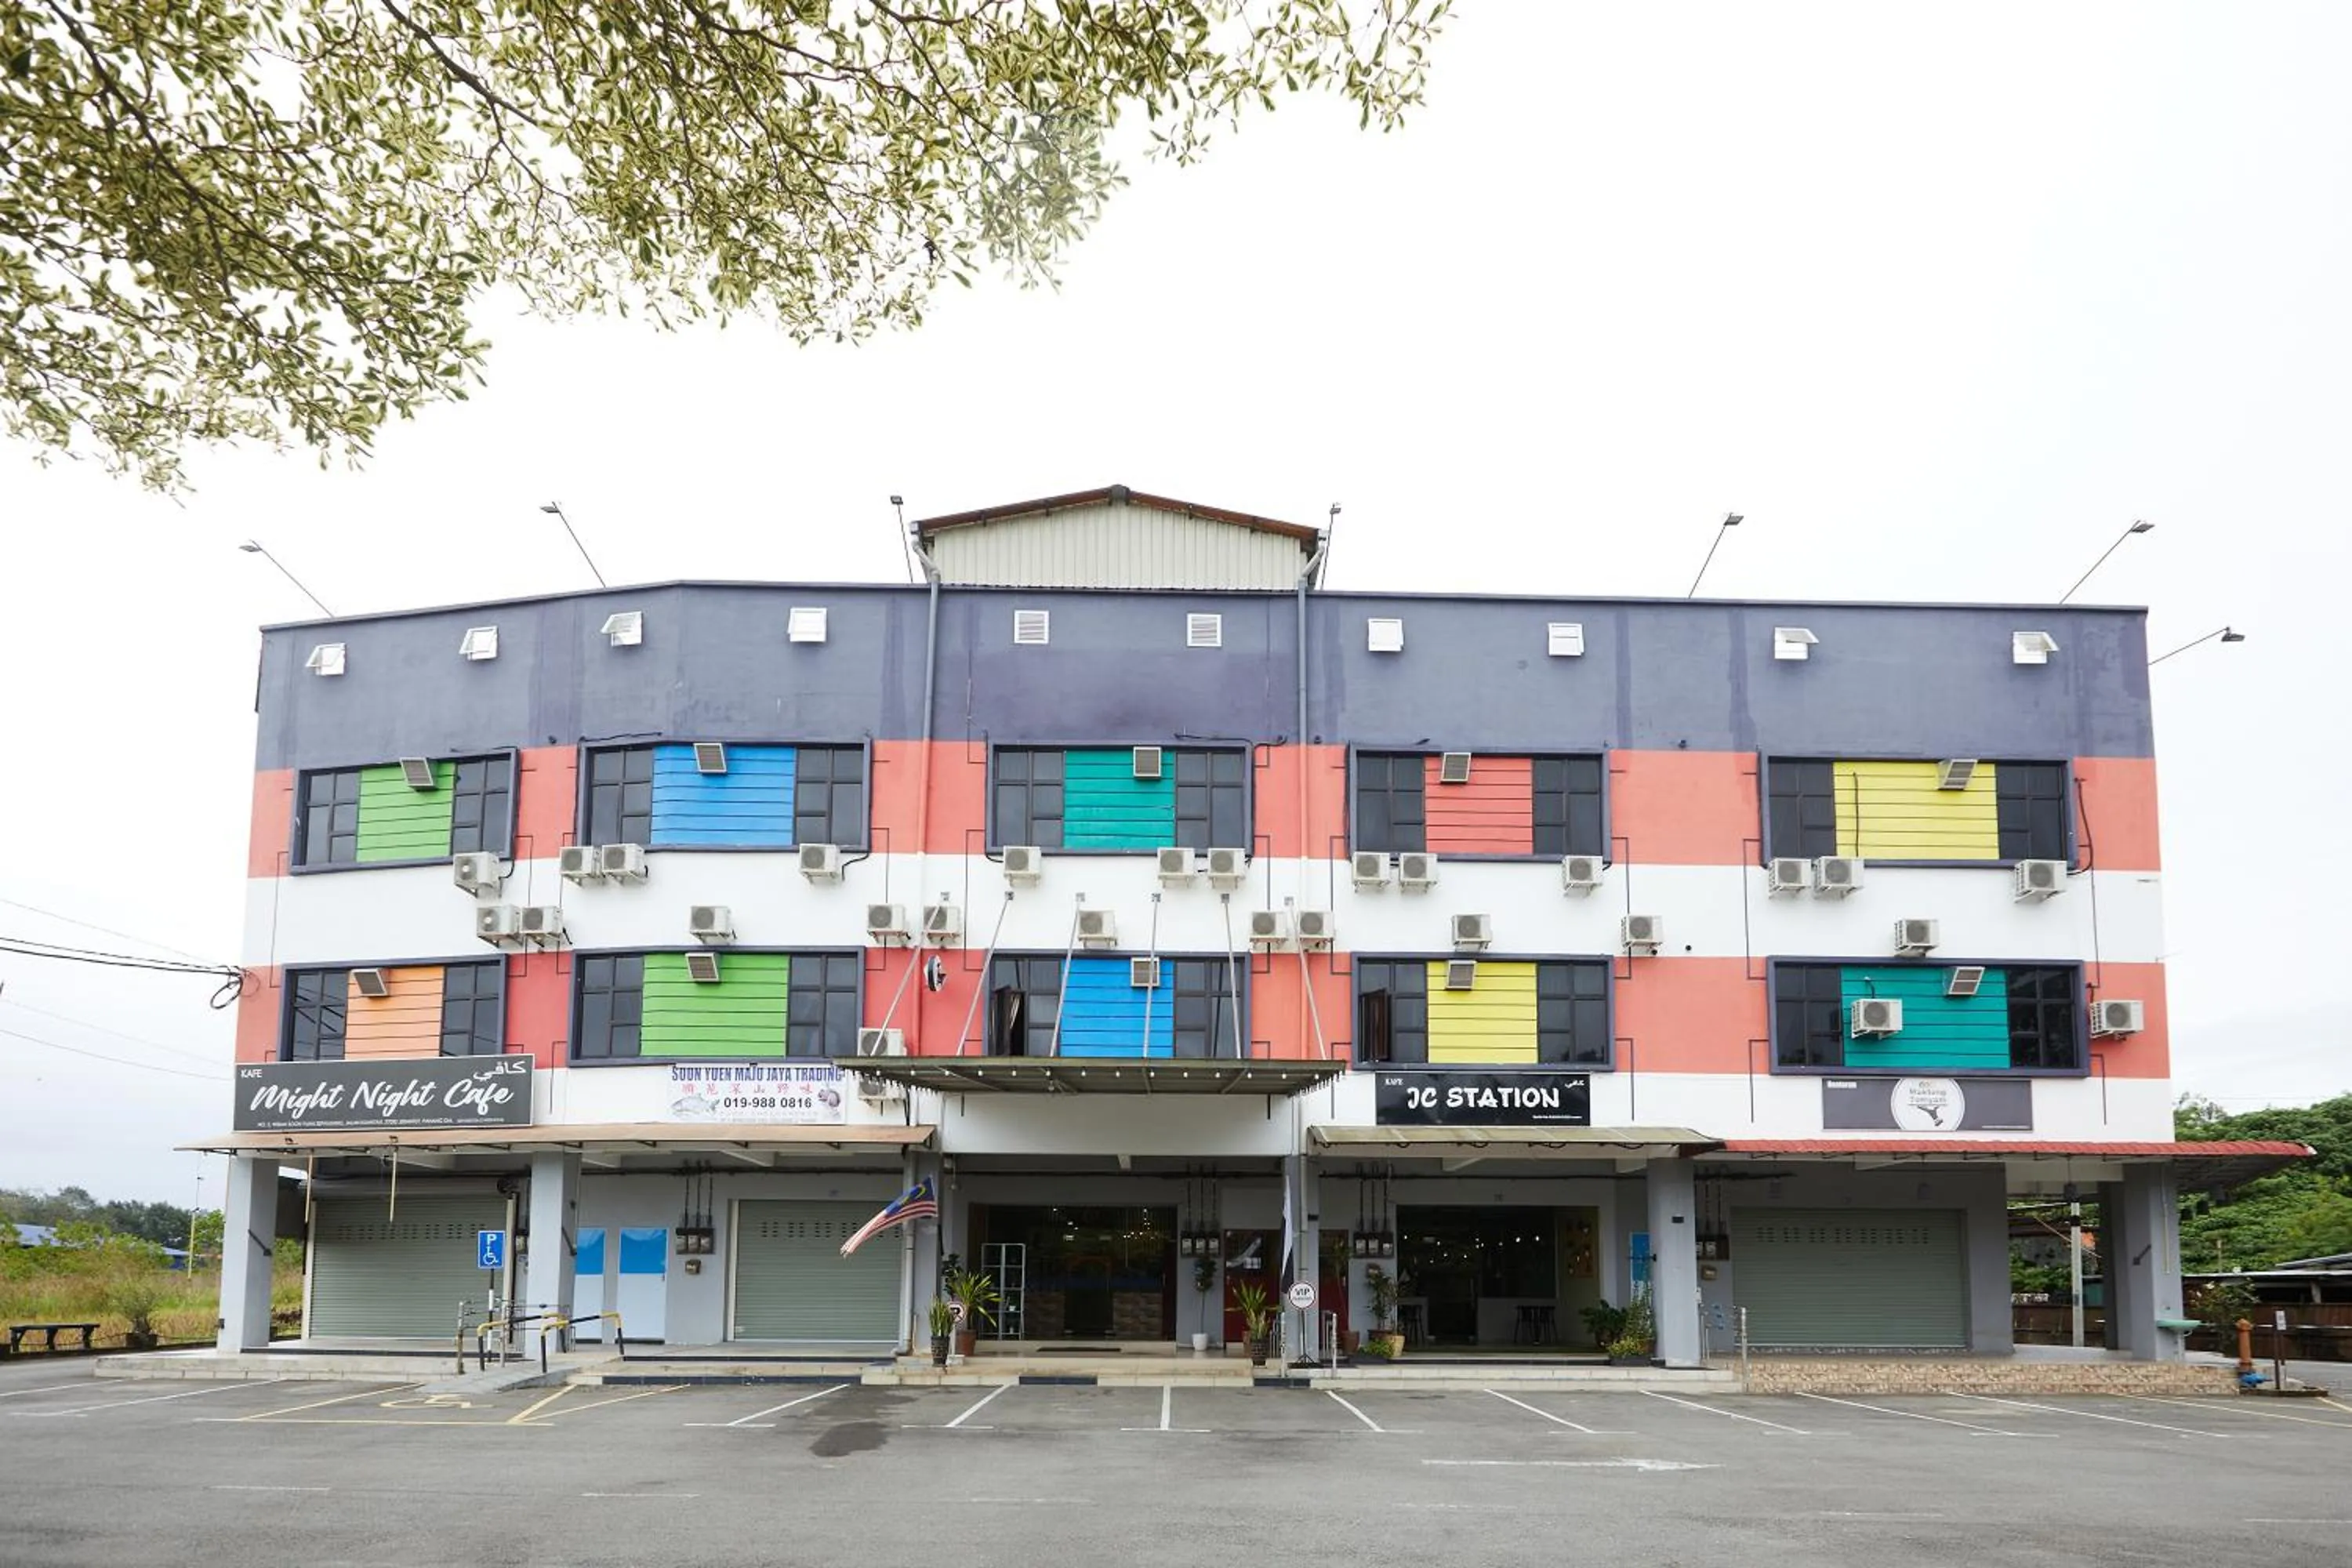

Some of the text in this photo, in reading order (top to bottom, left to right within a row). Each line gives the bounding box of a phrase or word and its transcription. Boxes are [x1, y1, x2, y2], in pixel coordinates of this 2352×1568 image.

[240, 1068, 263, 1078] KAFE
[473, 1061, 526, 1081] كافي
[672, 1065, 840, 1081] SOON YUEN MAJU JAYA TRADING
[250, 1078, 514, 1120] Might Night Cafe
[724, 1097, 812, 1108] 019-988 0816
[1407, 1087, 1560, 1109] JC STATION
[487, 1233, 497, 1245] P
